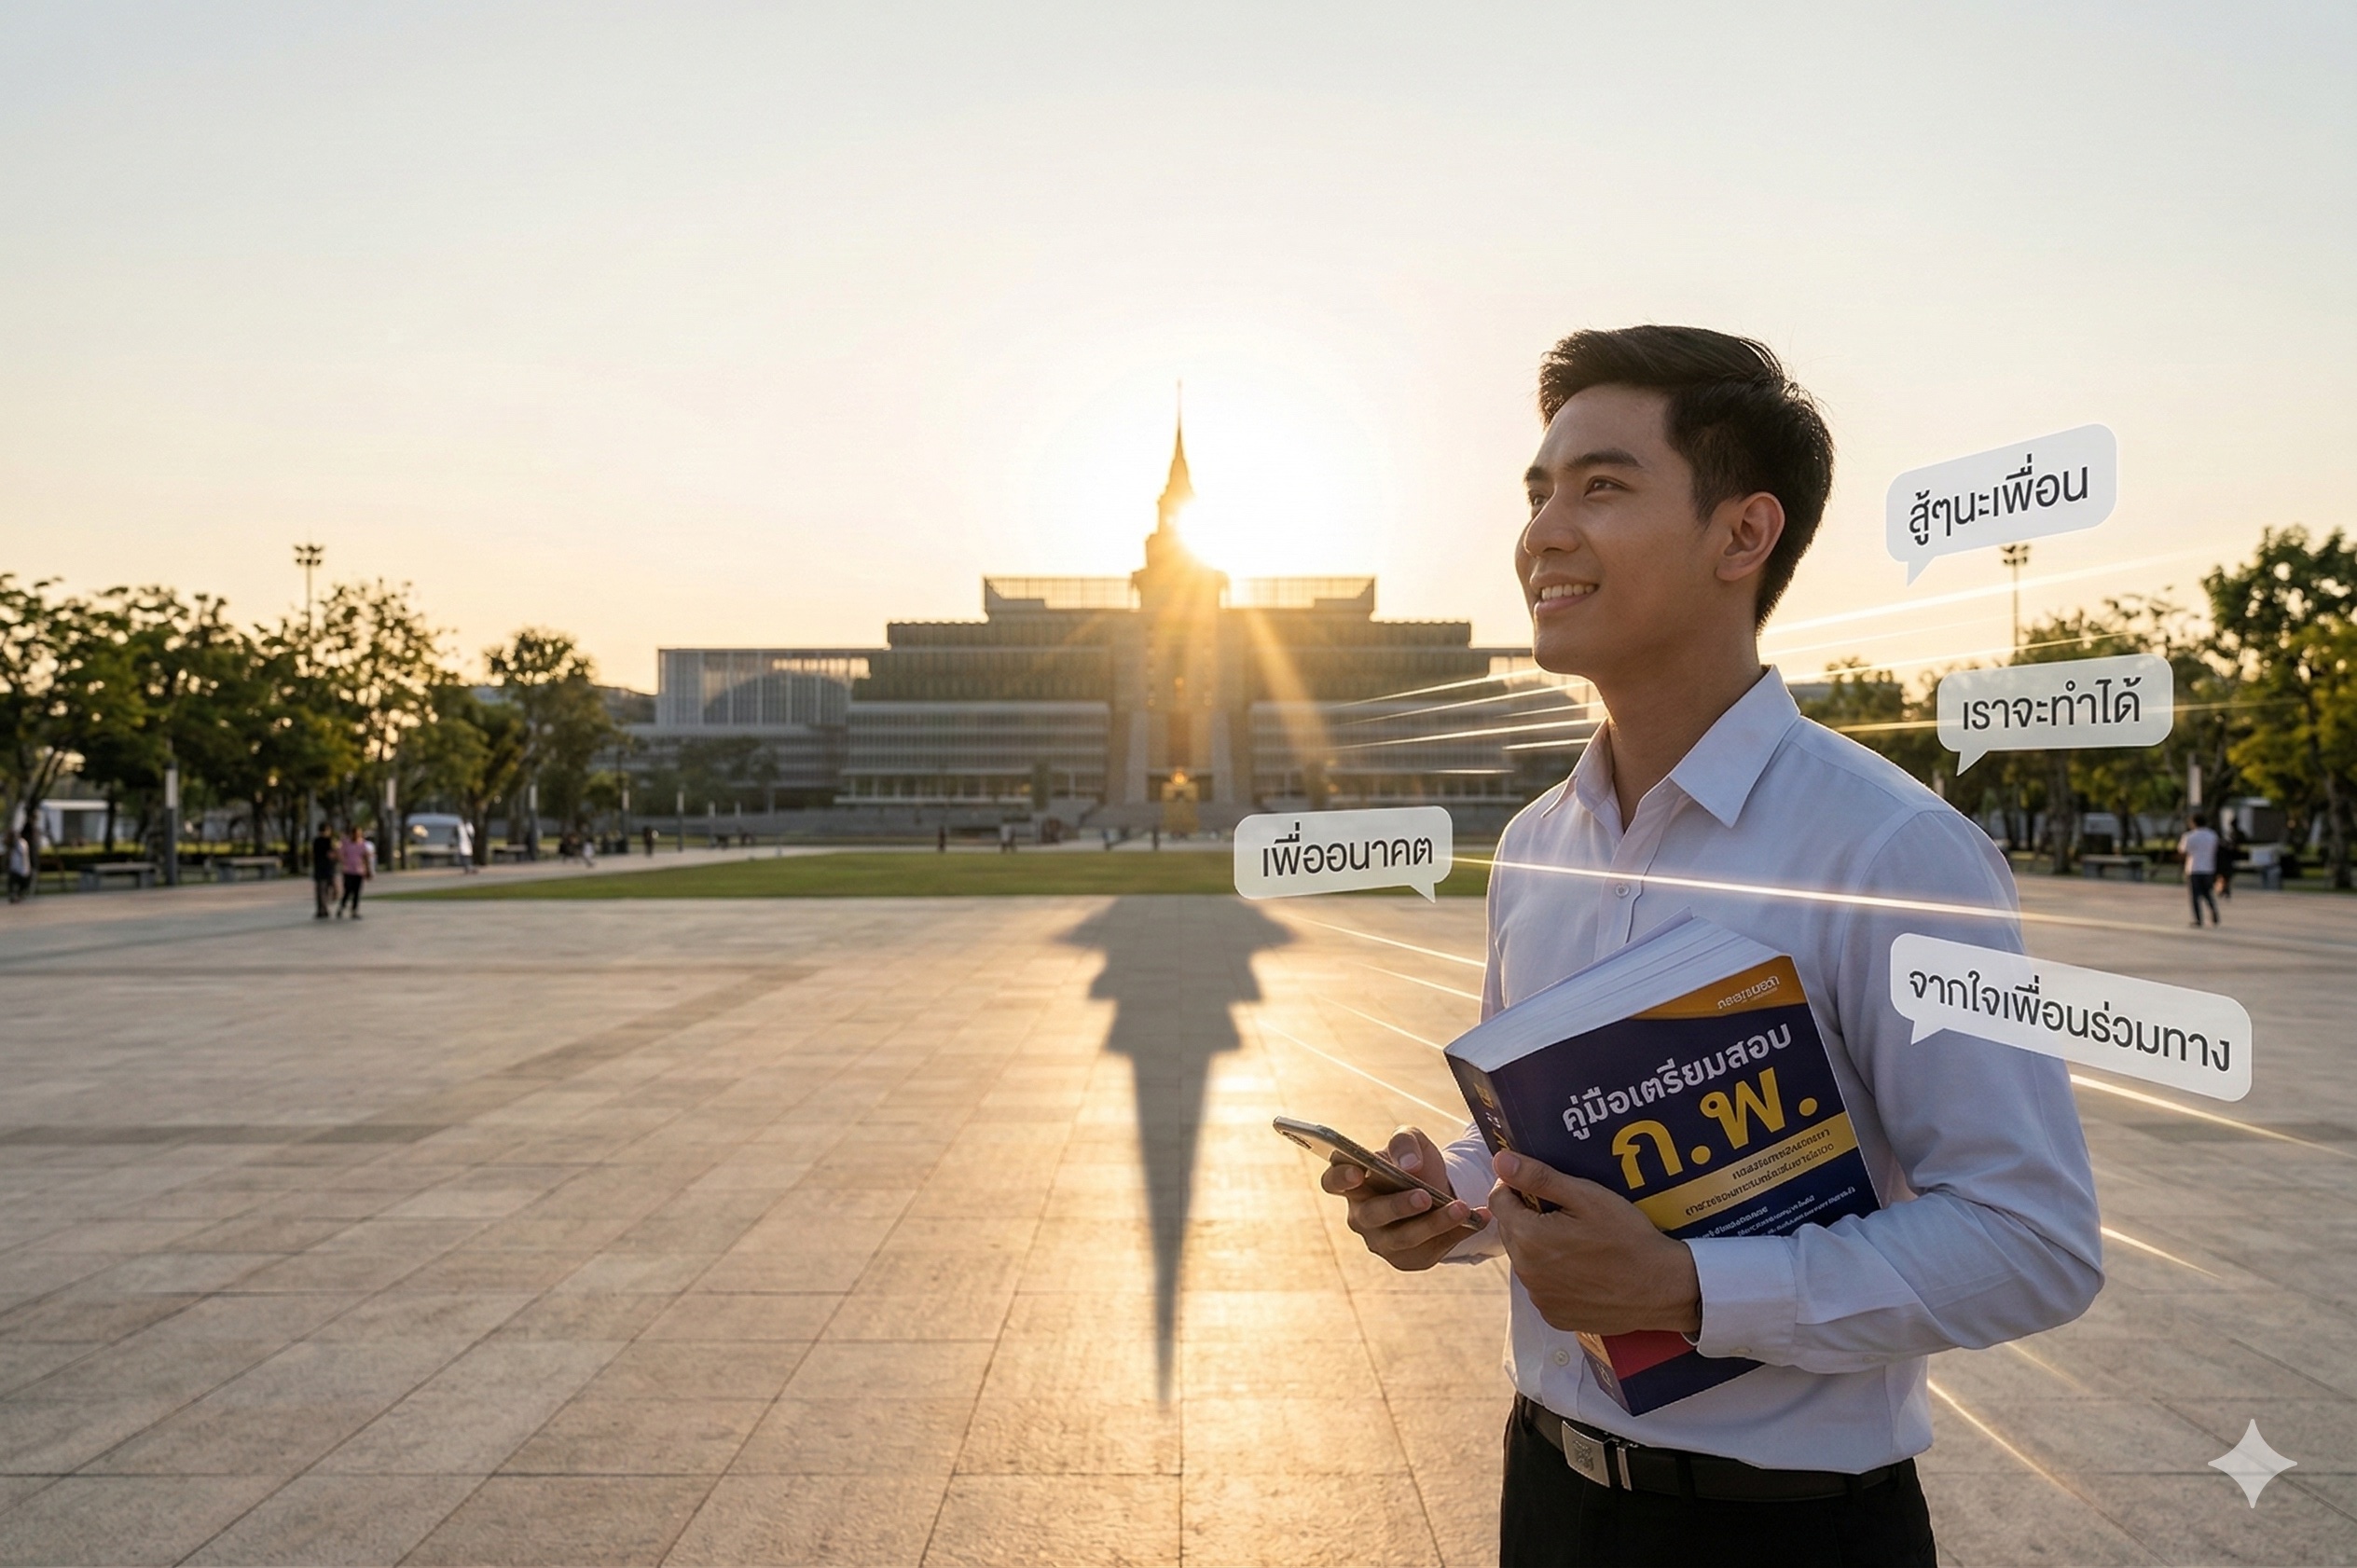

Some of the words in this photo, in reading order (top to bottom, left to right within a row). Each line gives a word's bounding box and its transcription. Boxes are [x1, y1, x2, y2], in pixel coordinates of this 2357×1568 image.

[1561, 1023, 1793, 1141] คู่มือเตรียมสอบ
[1611, 1066, 1819, 1190] ก.พ.
